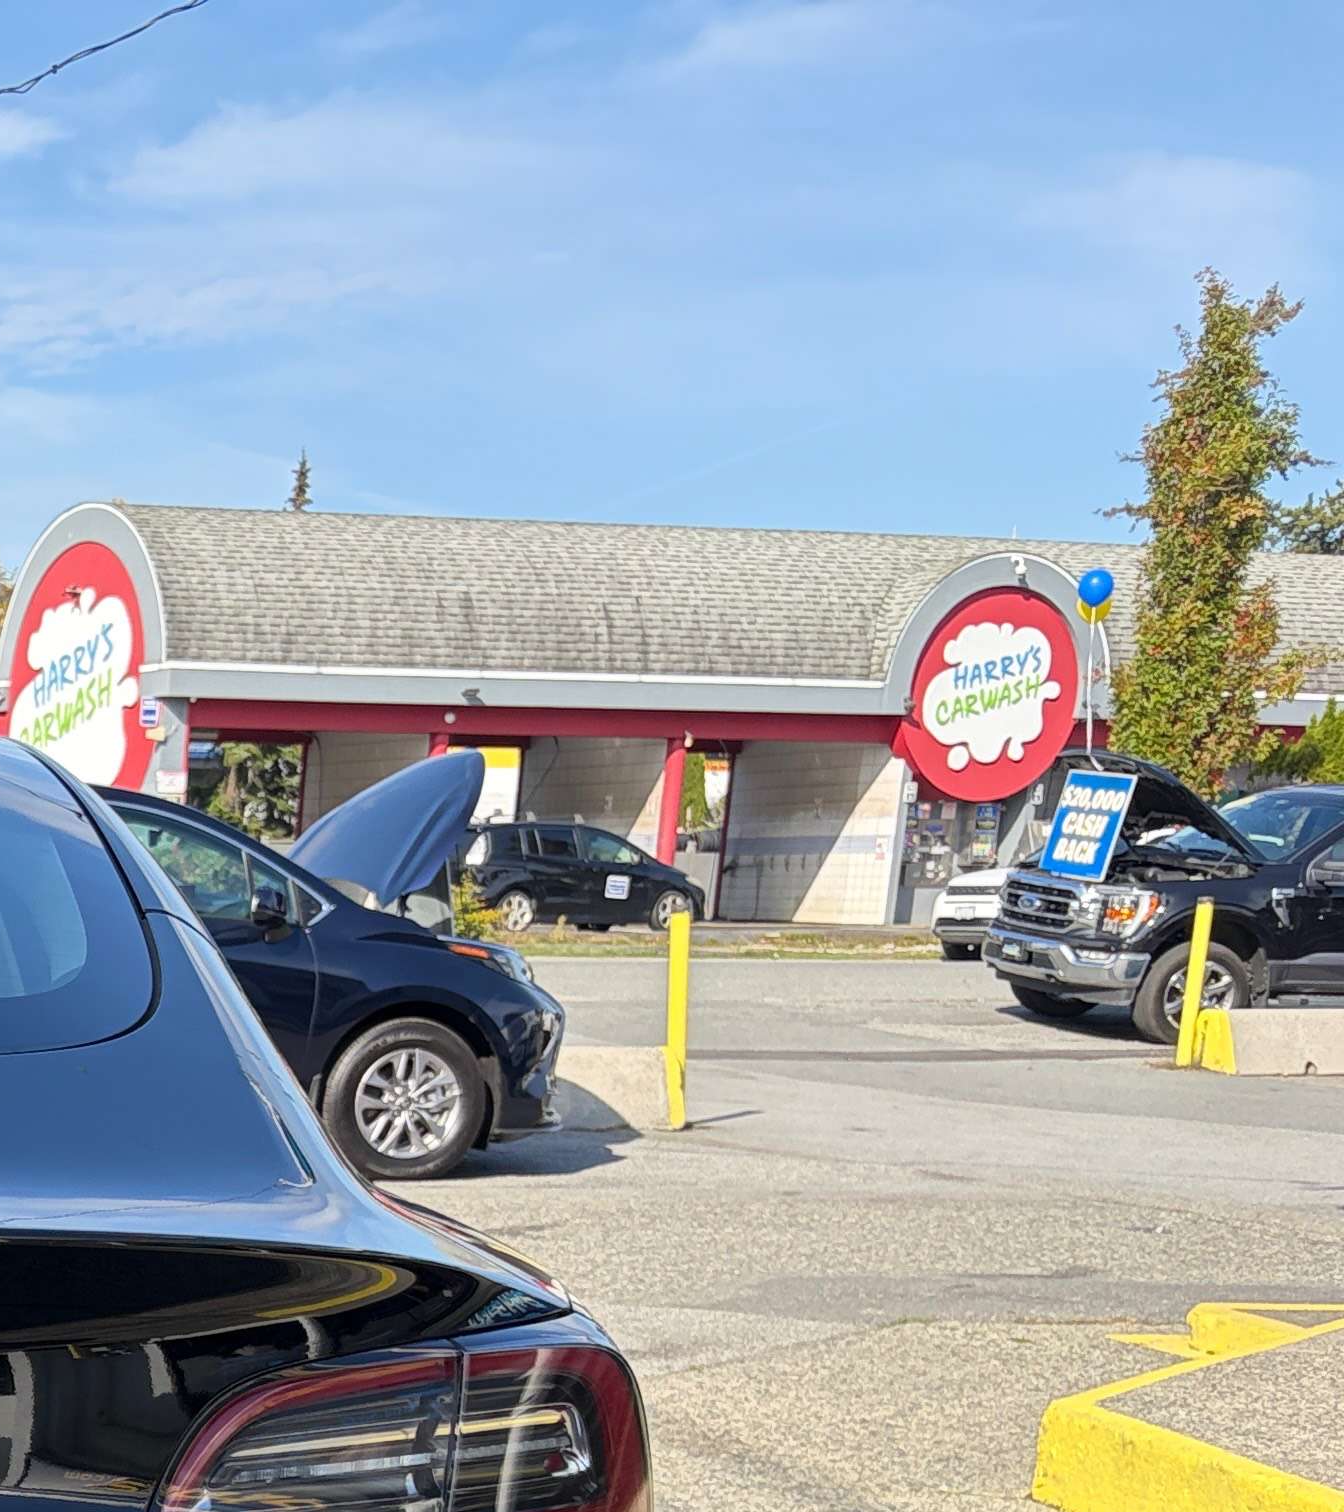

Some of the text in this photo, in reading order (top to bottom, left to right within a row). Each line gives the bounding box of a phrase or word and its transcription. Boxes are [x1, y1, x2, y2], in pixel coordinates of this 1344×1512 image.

[33, 622, 113, 708] HARRY'S
[952, 644, 1042, 690] HARRY'S
[935, 674, 1041, 726] CARWASH
[1061, 783, 1127, 812] $20,000
[1061, 811, 1110, 838] CASH
[1051, 837, 1102, 865] BACK
